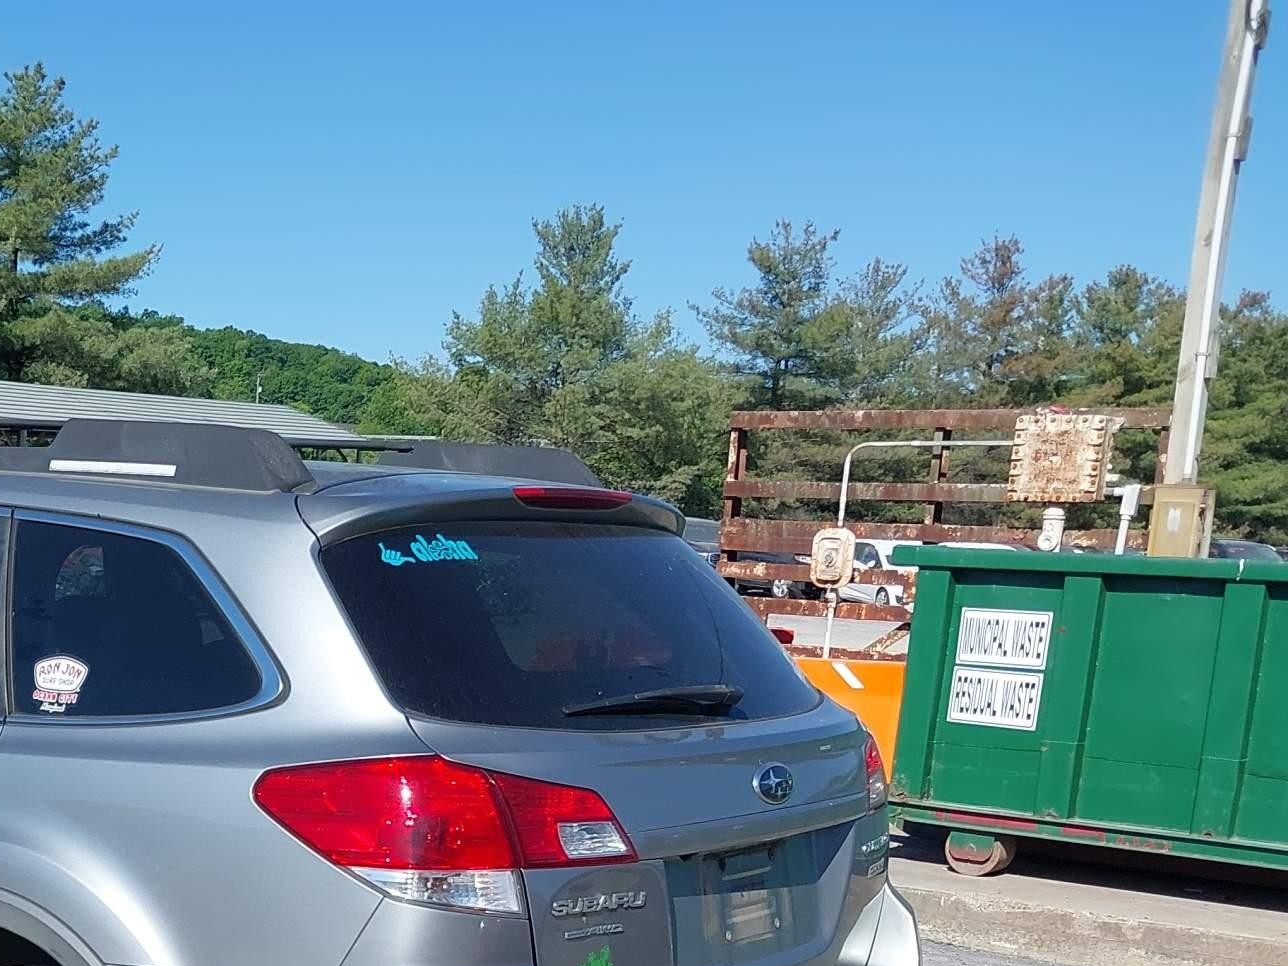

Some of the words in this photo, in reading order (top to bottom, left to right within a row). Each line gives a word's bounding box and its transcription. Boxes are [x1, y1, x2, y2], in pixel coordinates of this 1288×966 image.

[410, 534, 479, 562] aloha
[961, 617, 1010, 657] MUNICIPAL
[1012, 619, 1046, 659] WASTE
[39, 662, 61, 677] RON
[62, 663, 82, 680] JON
[33, 690, 58, 702] OCEAN
[58, 693, 79, 704] CITY
[952, 675, 1000, 717] RESIDUAL
[1000, 679, 1037, 720] WASTE
[552, 891, 646, 916] SUBARU
